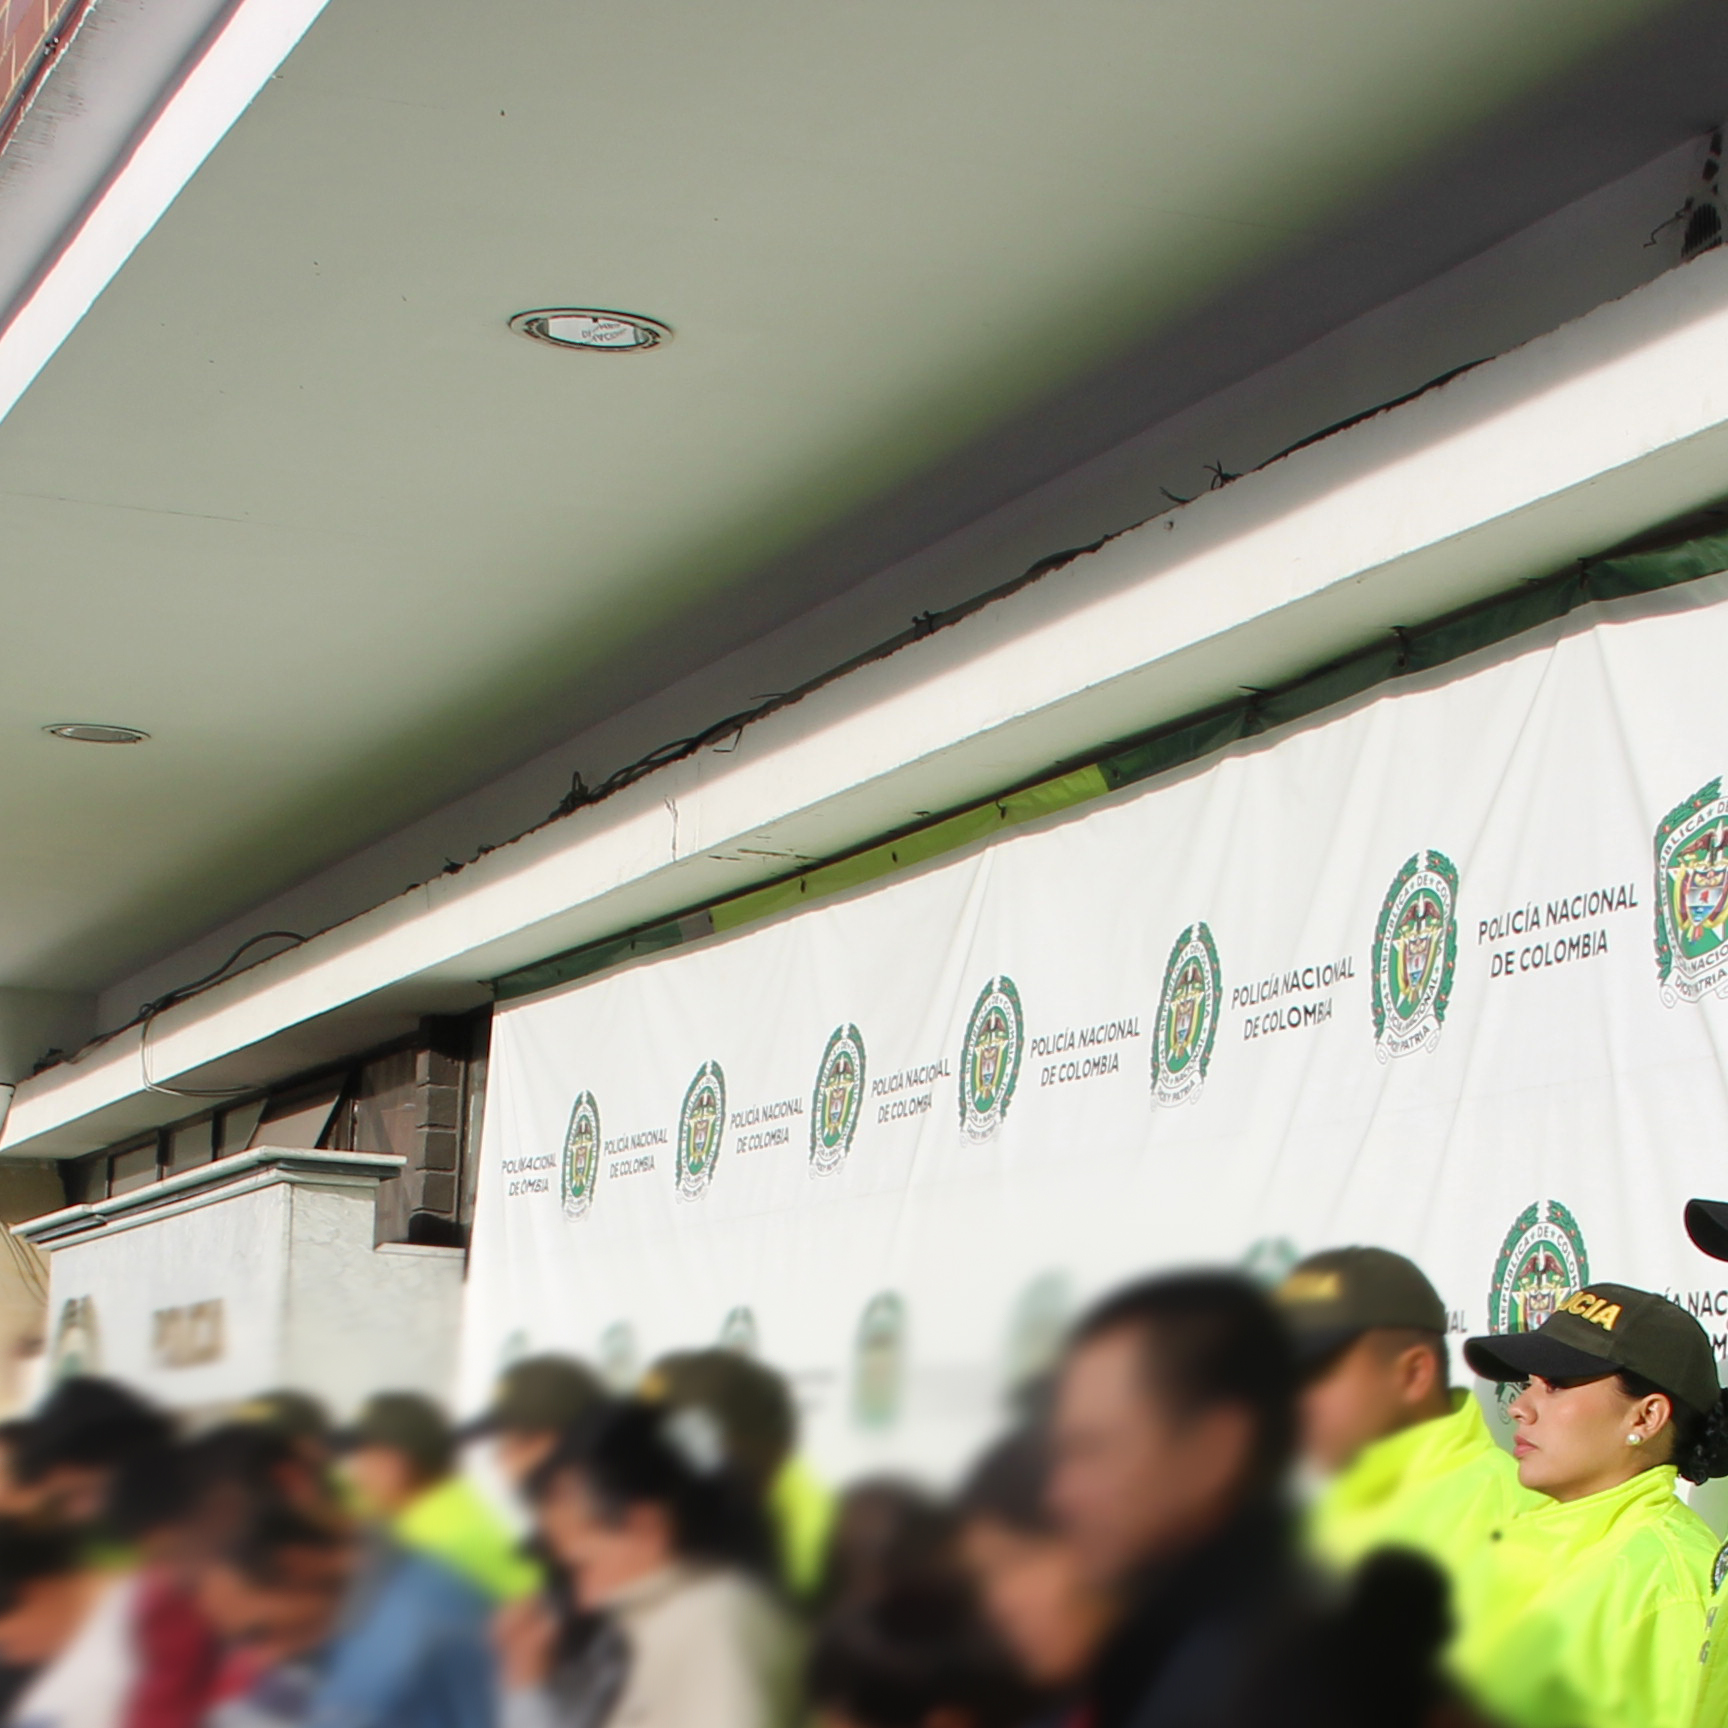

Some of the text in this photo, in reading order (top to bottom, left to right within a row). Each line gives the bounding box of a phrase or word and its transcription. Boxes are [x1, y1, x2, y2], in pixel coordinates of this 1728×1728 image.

[1477, 901, 1542, 945] POLICÍA
[1544, 882, 1640, 929] NACIONAL
[1490, 928, 1610, 979] DE COLOMBIA
[1230, 972, 1280, 1010] POLICÍA
[1280, 955, 1356, 997] NACIONAL
[1243, 997, 1333, 1041] DE COLOMBIA
[1029, 1016, 1142, 1059] POLICÍA NACIONAL
[870, 1069, 904, 1099] POLICÍA
[1040, 1052, 1120, 1088] DE COLOMBIA
[760, 1097, 804, 1125] NACIONAL
[877, 1104, 890, 1125] DE
[735, 1126, 790, 1155] DE COLOMBIA
[609, 1161, 619, 1179] DE
